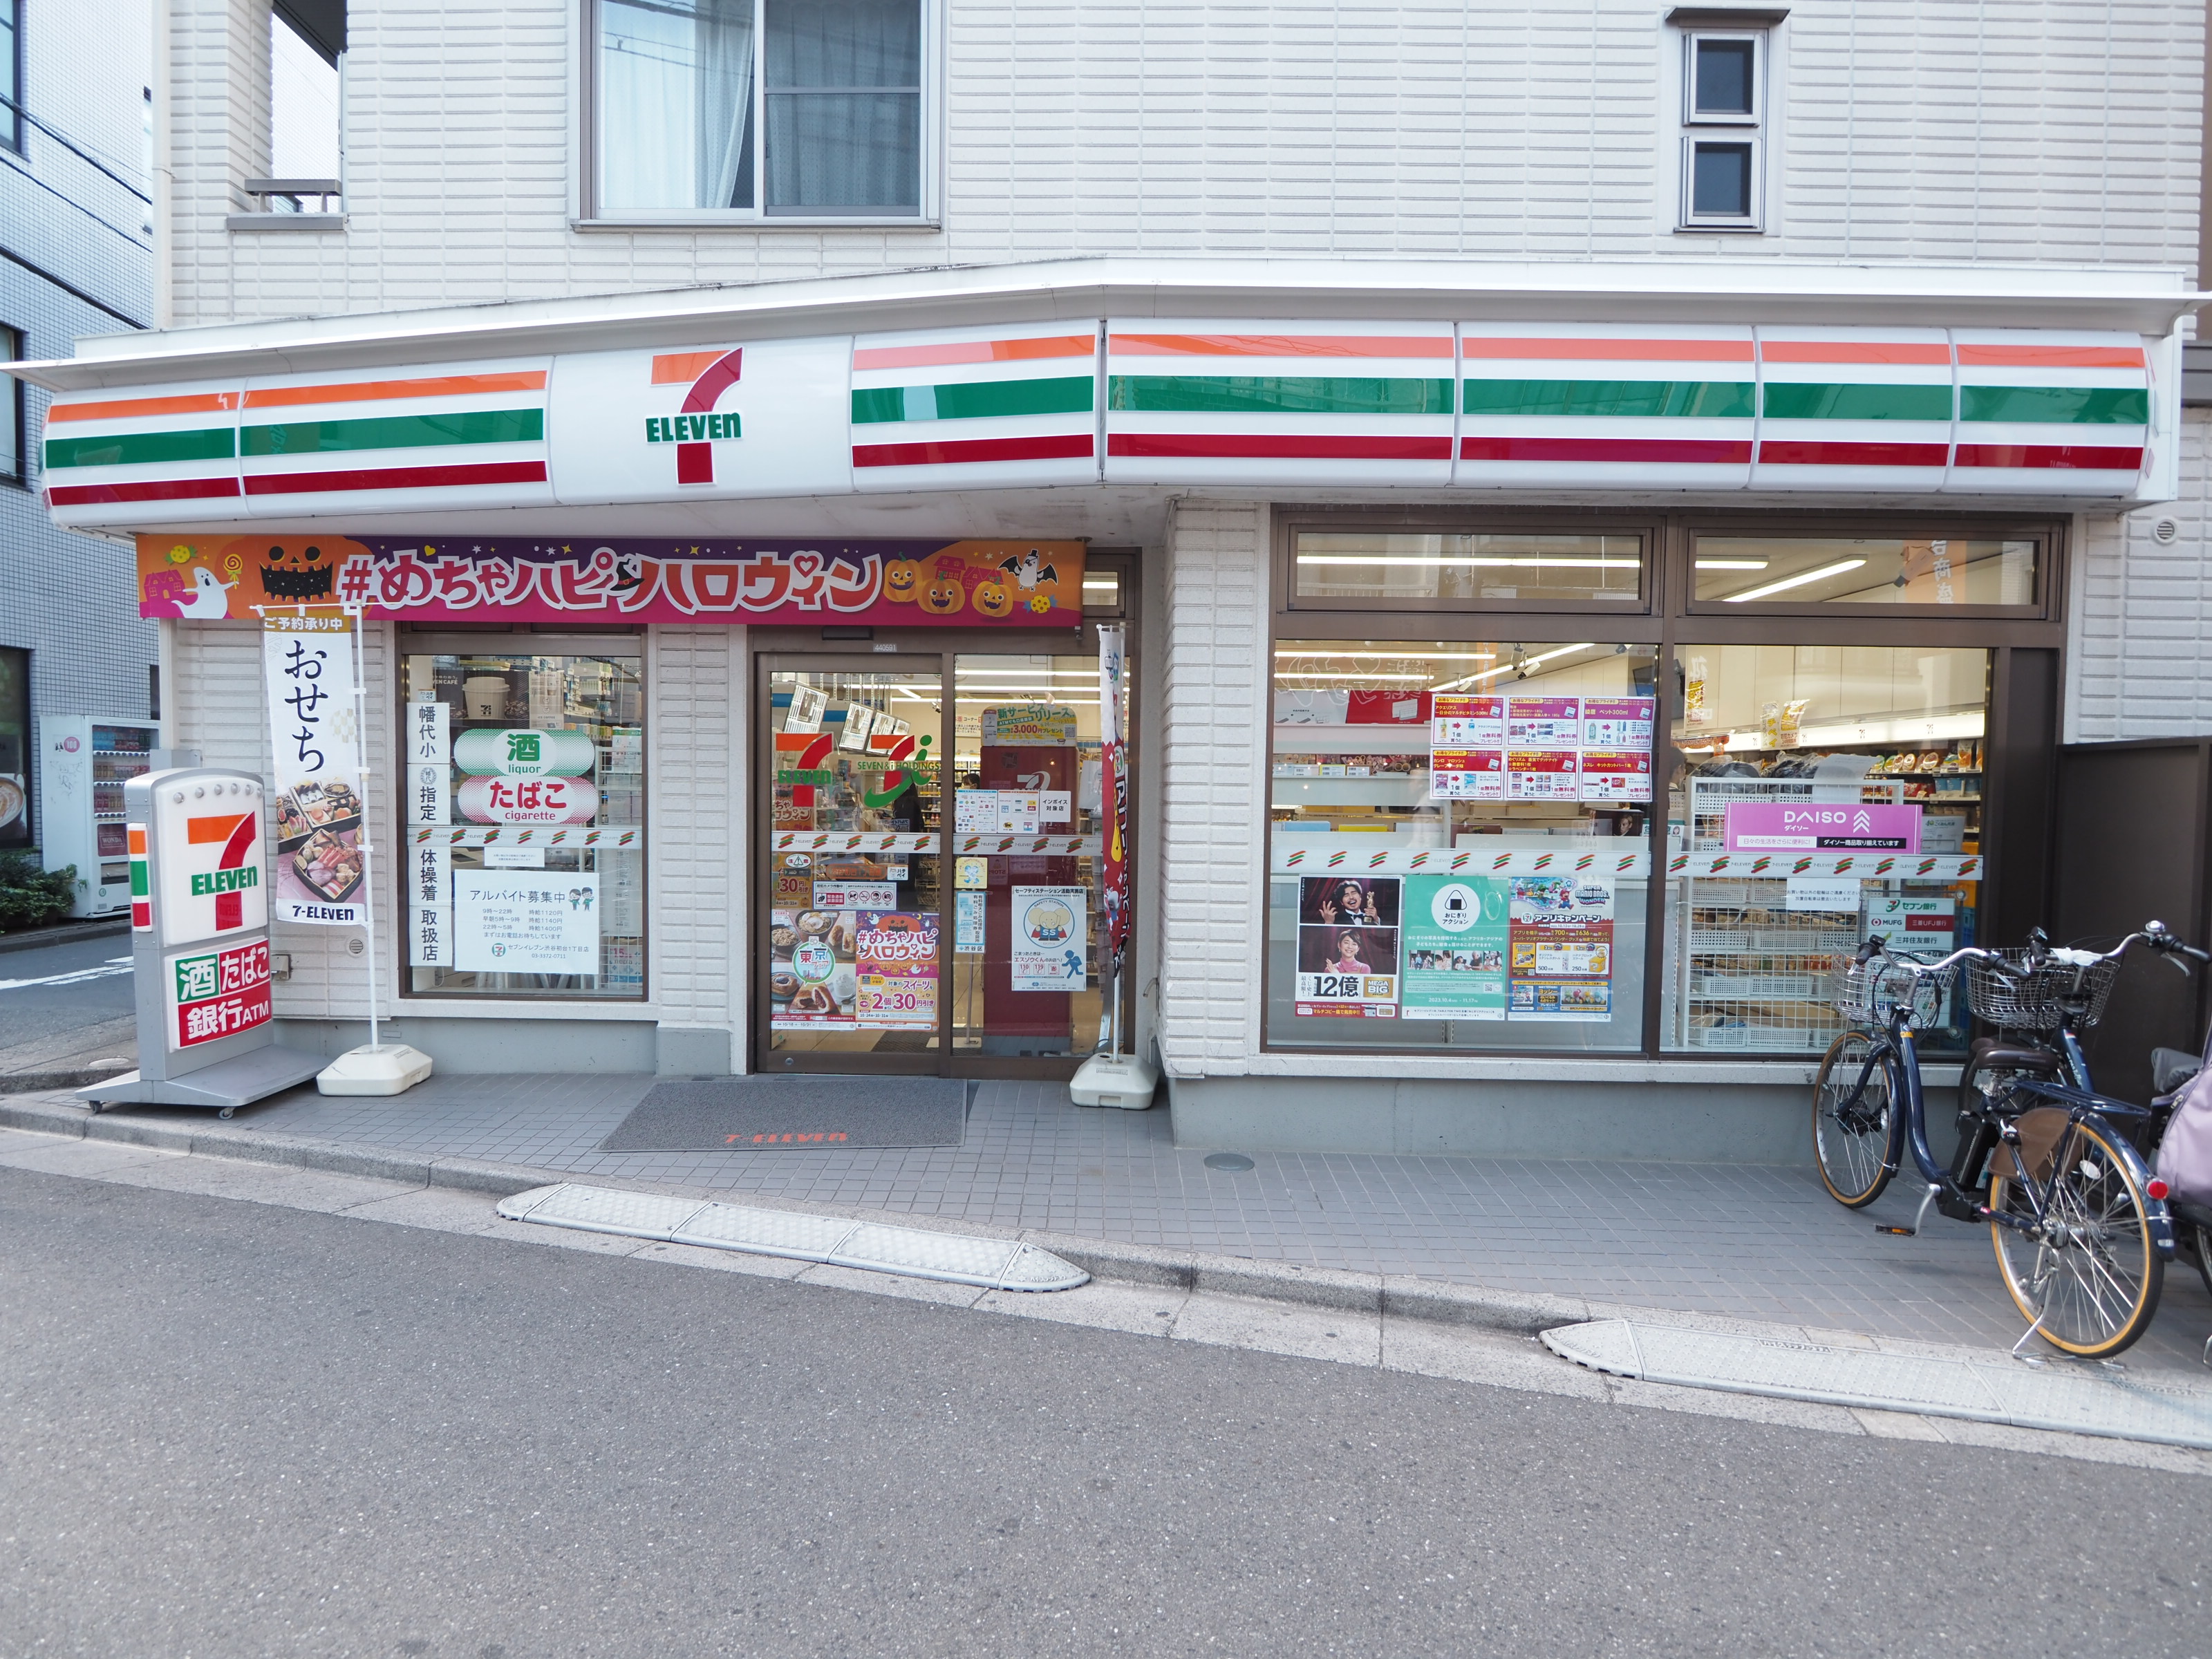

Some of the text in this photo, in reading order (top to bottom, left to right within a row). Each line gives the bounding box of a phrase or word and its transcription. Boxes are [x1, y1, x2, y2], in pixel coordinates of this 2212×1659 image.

[646, 412, 741, 442] ELEVEN
[264, 617, 343, 630] ご予約承り中
[284, 639, 329, 772] おせち
[997, 704, 1044, 719] 新サービス
[418, 705, 437, 759] 幡代小
[66, 740, 78, 750] 100
[507, 733, 541, 762] 酒
[508, 764, 541, 775] liquor
[896, 761, 939, 771] HOLDINGS
[778, 769, 832, 784] ELEVEN
[489, 781, 568, 810] たばこ
[420, 786, 437, 821] 指定
[505, 810, 556, 822] cigarette
[1784, 811, 1846, 824] DAISO
[102, 836, 123, 844] WONDA
[1823, 838, 1900, 847] ダイソー商品取り揃えています
[191, 865, 258, 897] ELEVEN
[420, 849, 438, 902] 体操着
[470, 890, 565, 903] アルバイト募集中
[1049, 899, 1065, 908] STATION
[292, 905, 354, 921] 7-ELEVEN
[1902, 902, 1937, 910] セブン銀行
[1534, 914, 1602, 923] アプリキャンペーン
[421, 908, 439, 962] 取扱店
[799, 948, 827, 964] 東京
[861, 944, 936, 960] ハロウィン
[811, 961, 830, 969] フェア
[179, 948, 269, 1000] 酒 たばこ
[1313, 976, 1359, 997] 12億
[1368, 986, 1389, 994] BIG
[724, 1132, 847, 1144] 7-ELEVEN
